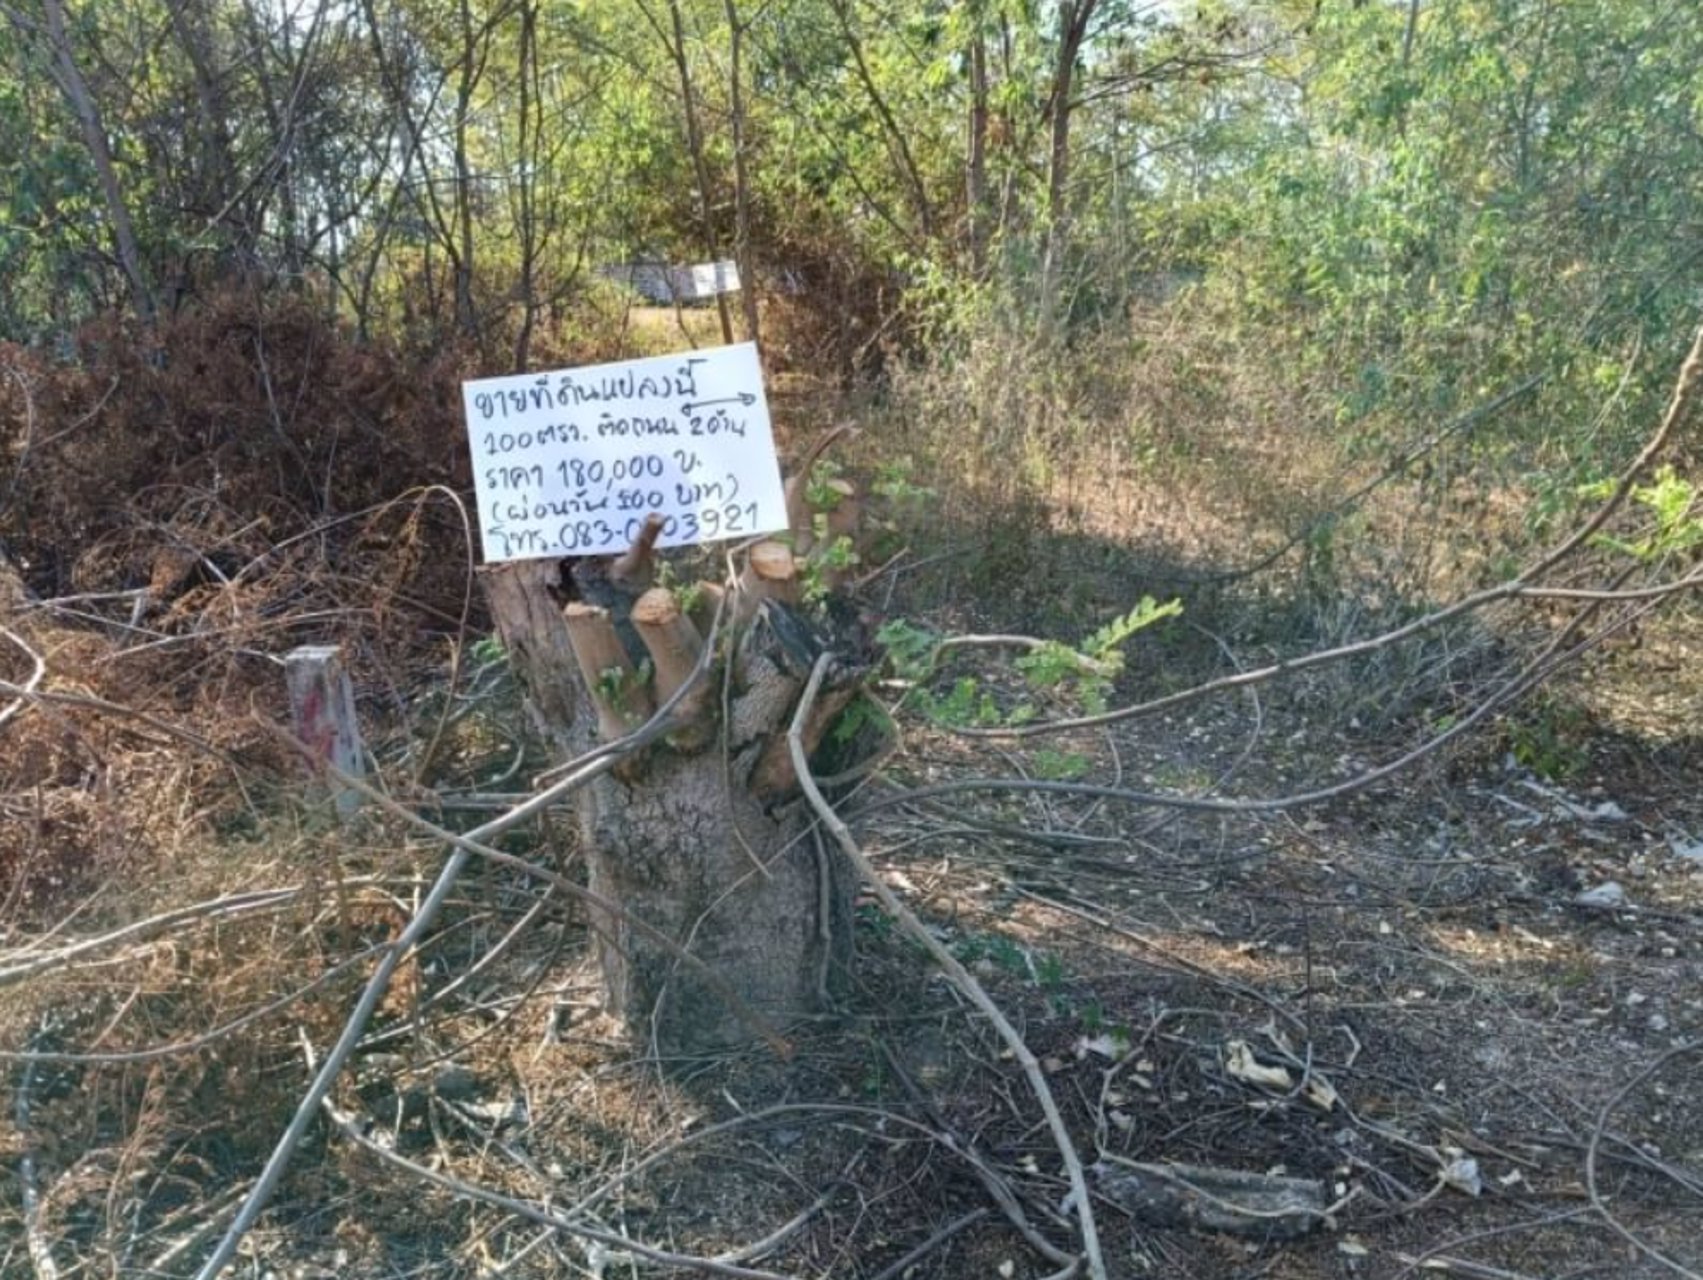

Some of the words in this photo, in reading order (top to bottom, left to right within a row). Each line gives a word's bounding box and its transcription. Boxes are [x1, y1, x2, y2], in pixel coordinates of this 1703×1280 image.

[485, 464, 544, 490] ราคา
[556, 453, 664, 492] 180,000
[674, 472, 740, 507] บาท)
